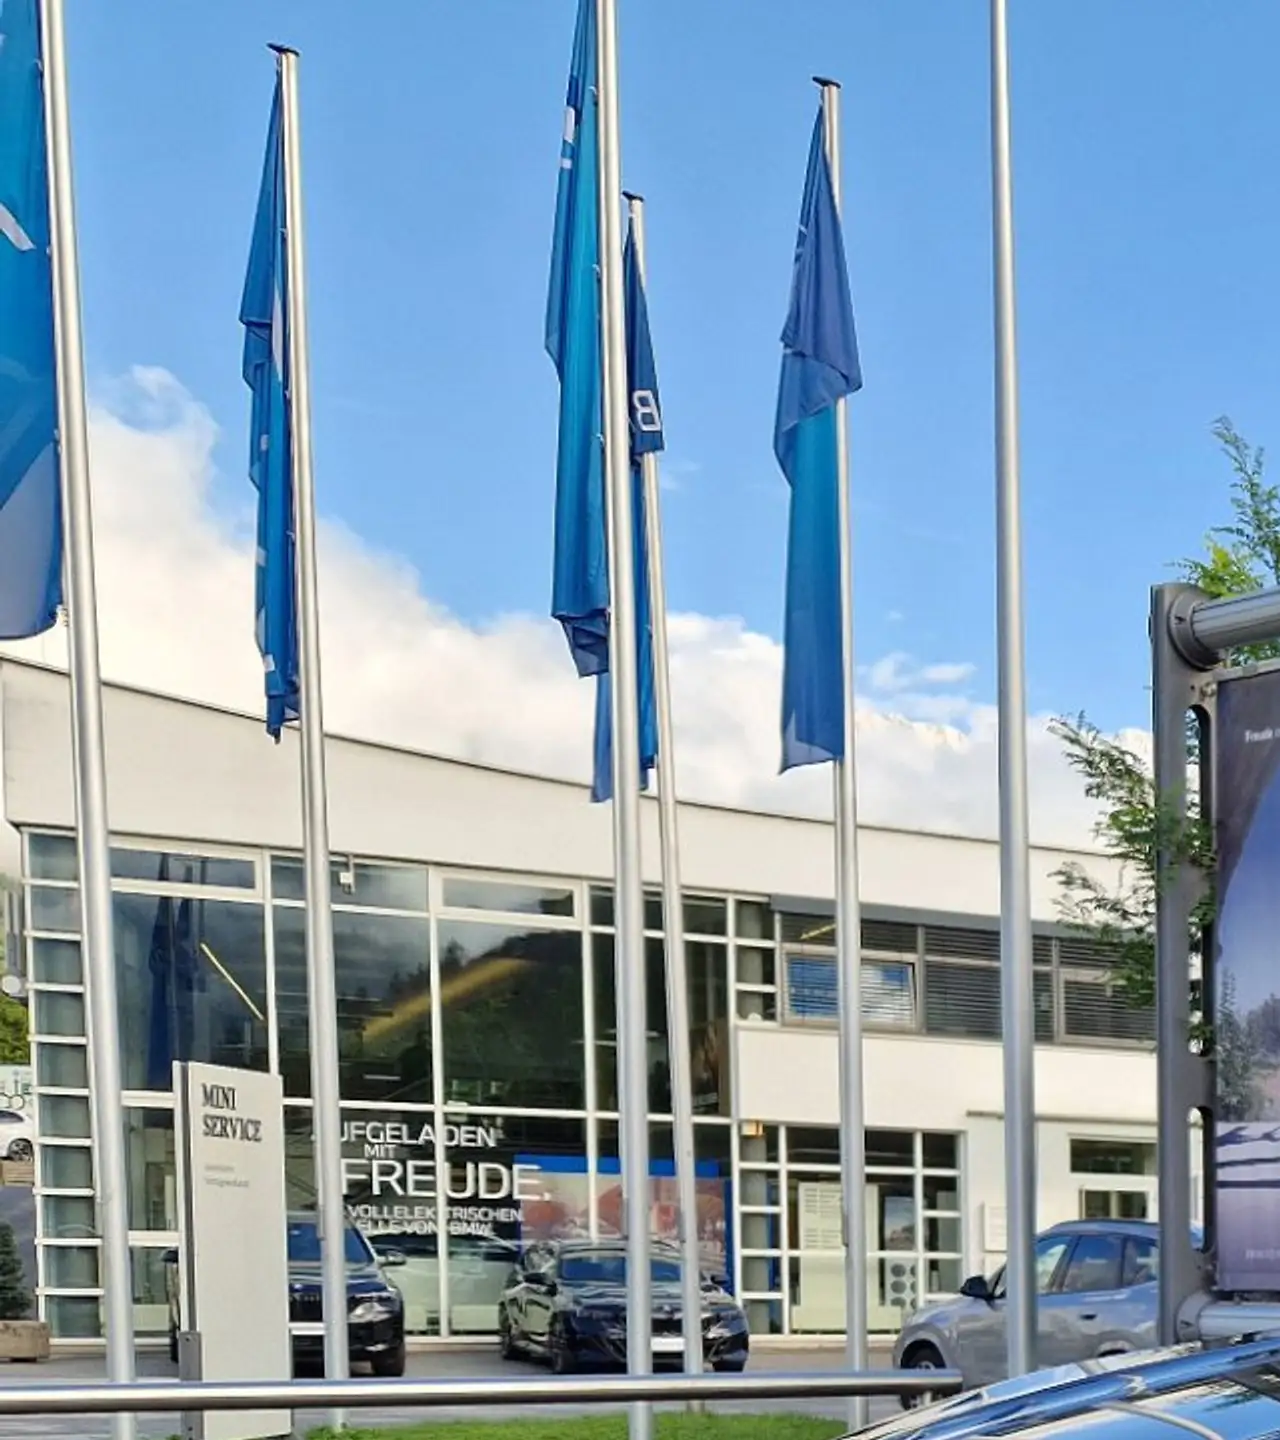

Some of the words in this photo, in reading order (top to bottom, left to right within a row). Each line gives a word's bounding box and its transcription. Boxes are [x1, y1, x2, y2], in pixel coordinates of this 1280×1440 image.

[202, 1083, 236, 1110] MINI
[203, 1114, 262, 1142] SERVICE
[364, 1143, 396, 1158] MIT
